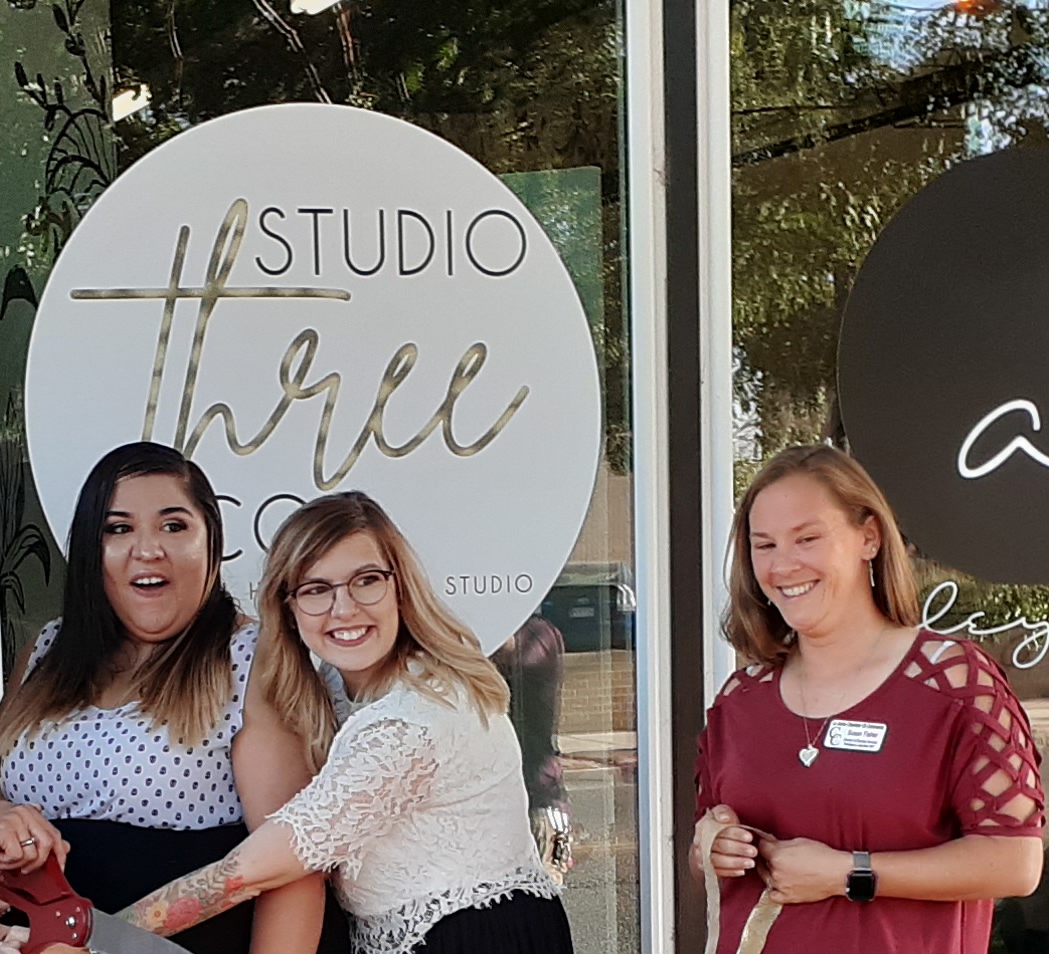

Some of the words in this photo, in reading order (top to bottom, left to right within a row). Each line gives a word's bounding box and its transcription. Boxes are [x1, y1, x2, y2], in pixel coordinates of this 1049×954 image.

[255, 206, 527, 276] STUDIO
[69, 198, 530, 491] three
[445, 574, 533, 596] STUDIO
